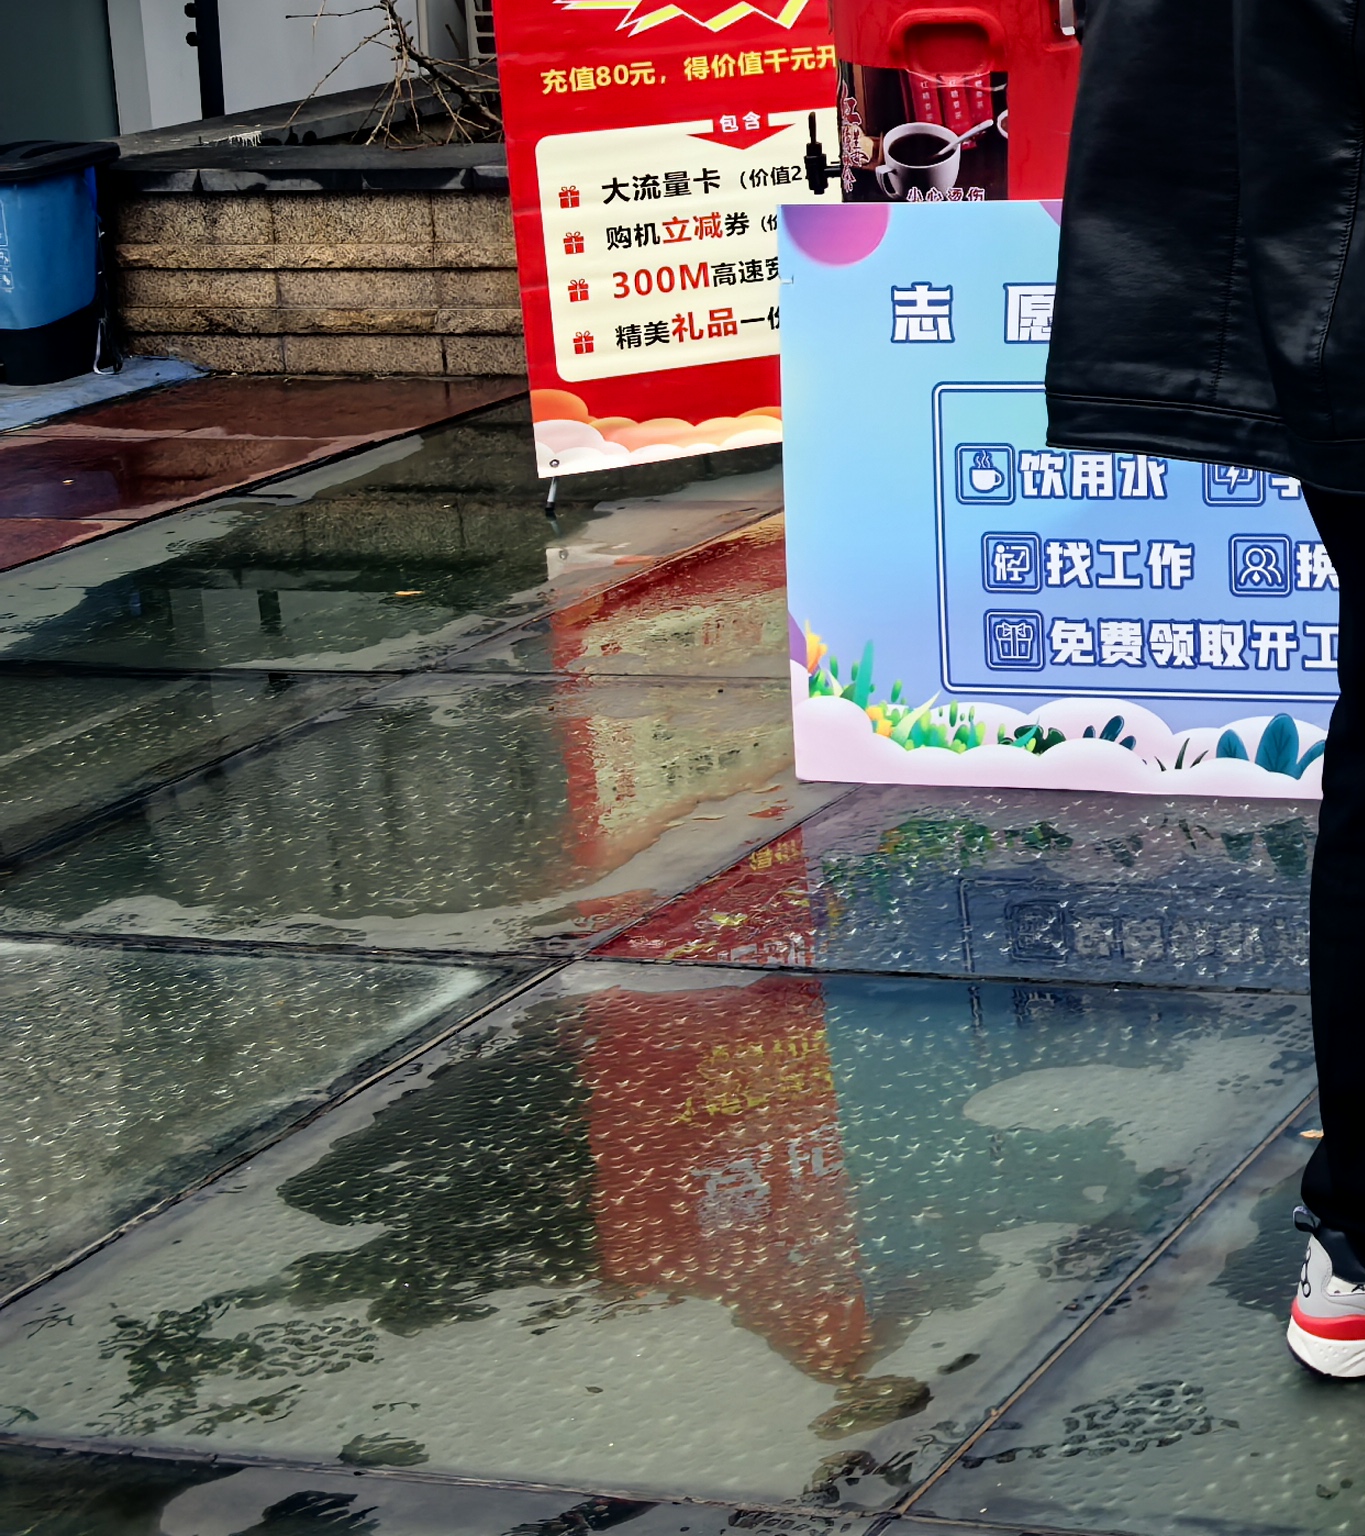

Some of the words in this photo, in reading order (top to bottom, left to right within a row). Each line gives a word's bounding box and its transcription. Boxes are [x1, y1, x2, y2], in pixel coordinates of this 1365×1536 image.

[719, 111, 761, 134] 包含
[1017, 450, 1169, 500] 饮用水
[1043, 539, 1196, 591] 找工作
[1049, 615, 1340, 672] 免费领取开工
